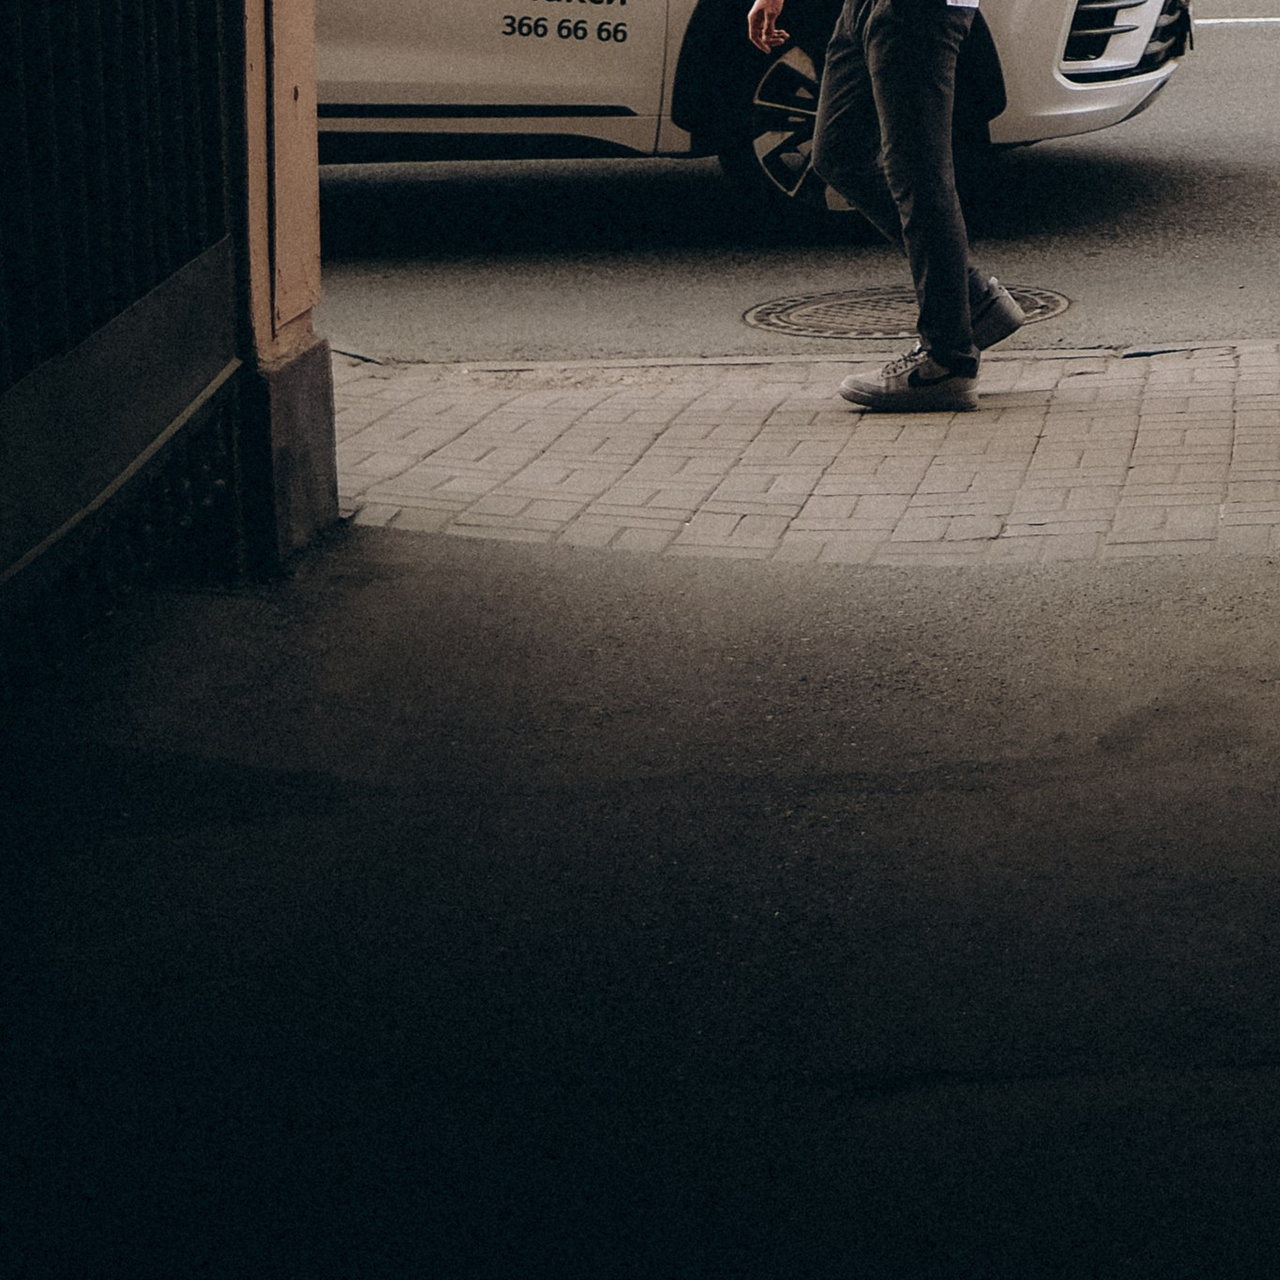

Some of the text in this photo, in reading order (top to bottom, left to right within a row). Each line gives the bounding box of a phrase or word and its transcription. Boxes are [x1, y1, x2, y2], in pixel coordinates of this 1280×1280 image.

[502, 15, 628, 43] 366 66 66
